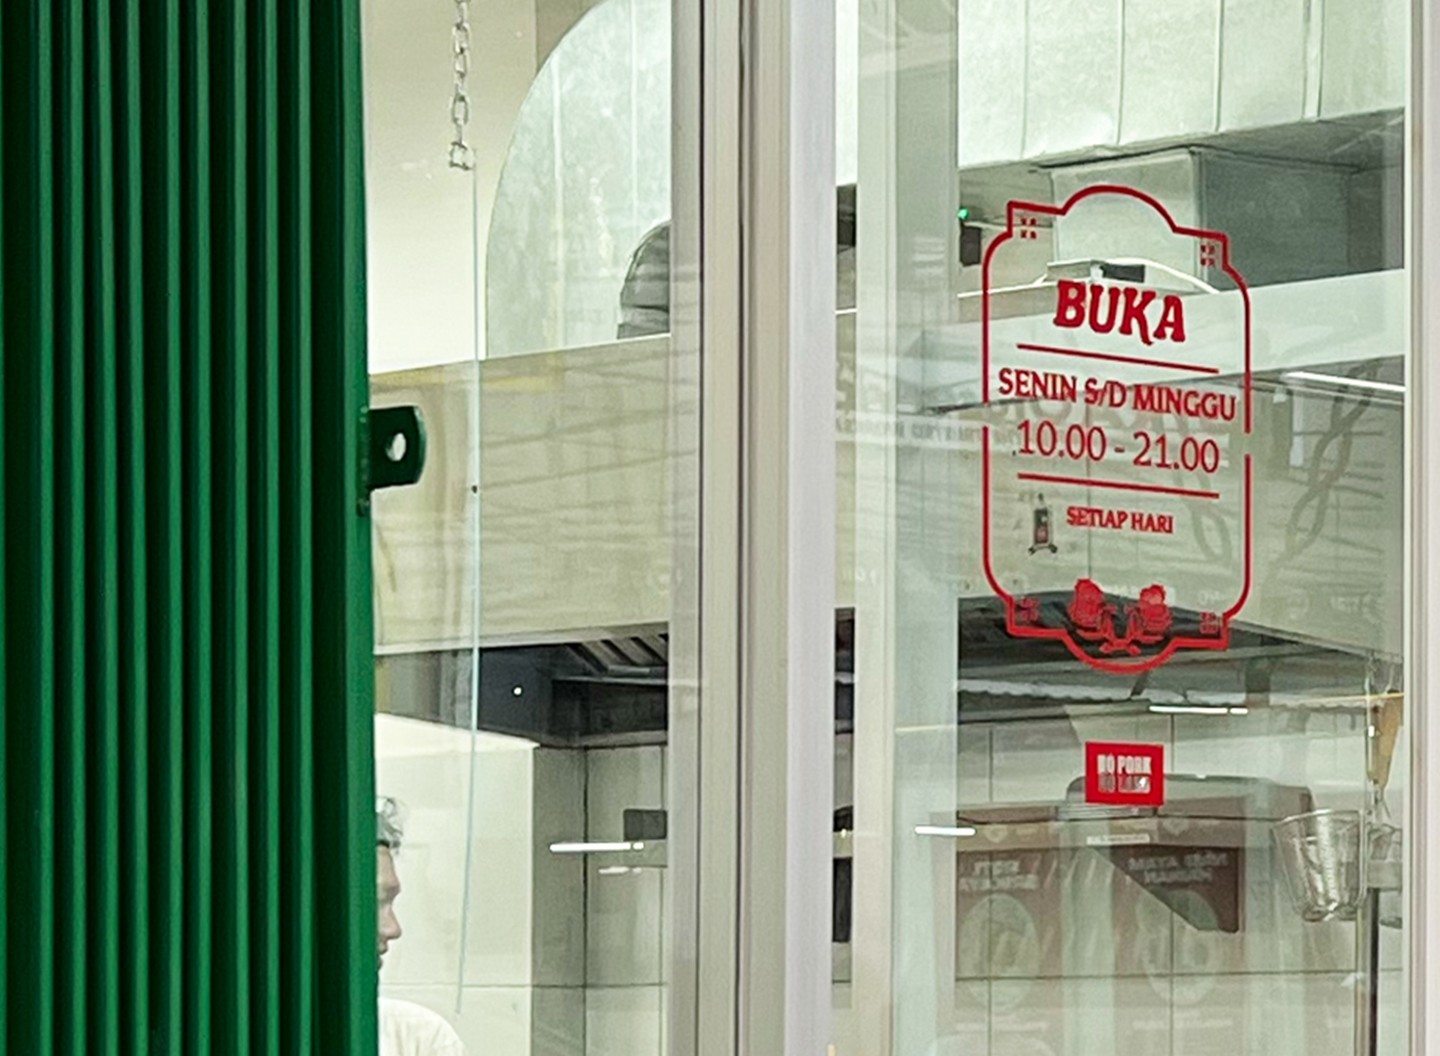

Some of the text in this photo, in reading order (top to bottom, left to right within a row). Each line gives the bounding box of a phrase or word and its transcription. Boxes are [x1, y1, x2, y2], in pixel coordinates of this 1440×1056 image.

[1053, 279, 1187, 346] BUKA
[998, 368, 1079, 402] SENIN
[1083, 377, 1129, 409] S/D
[1132, 383, 1238, 422] MINGGU
[1017, 419, 1108, 462] 10.00
[1132, 431, 1221, 474] 21.00
[1066, 505, 1174, 535] SETIAP HARI
[1096, 753, 1153, 775] NO PORK
